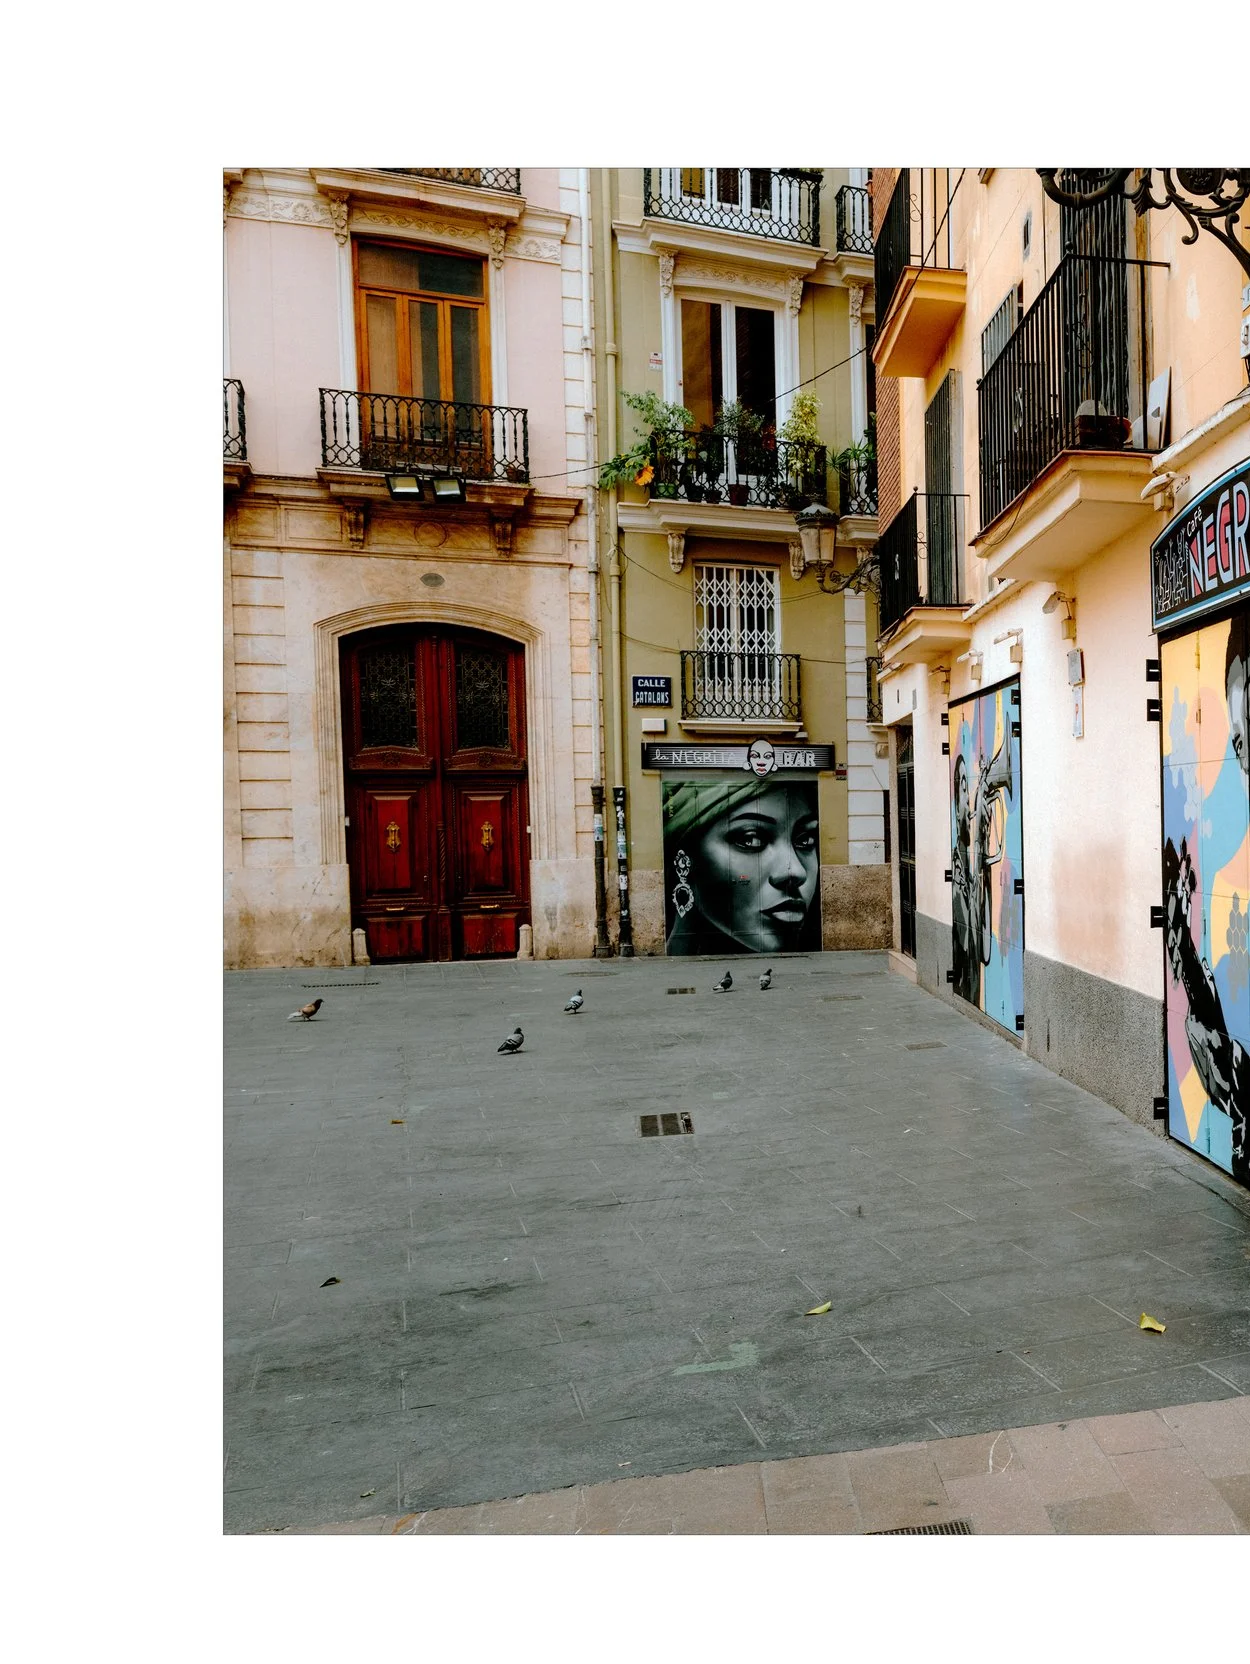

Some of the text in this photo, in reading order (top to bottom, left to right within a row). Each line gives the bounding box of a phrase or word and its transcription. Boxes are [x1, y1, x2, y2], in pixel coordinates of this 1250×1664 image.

[638, 678, 665, 687] CALLE
[635, 691, 669, 704] CATALANS
[672, 749, 738, 765] NEGRITA
[783, 751, 816, 767] BAR
